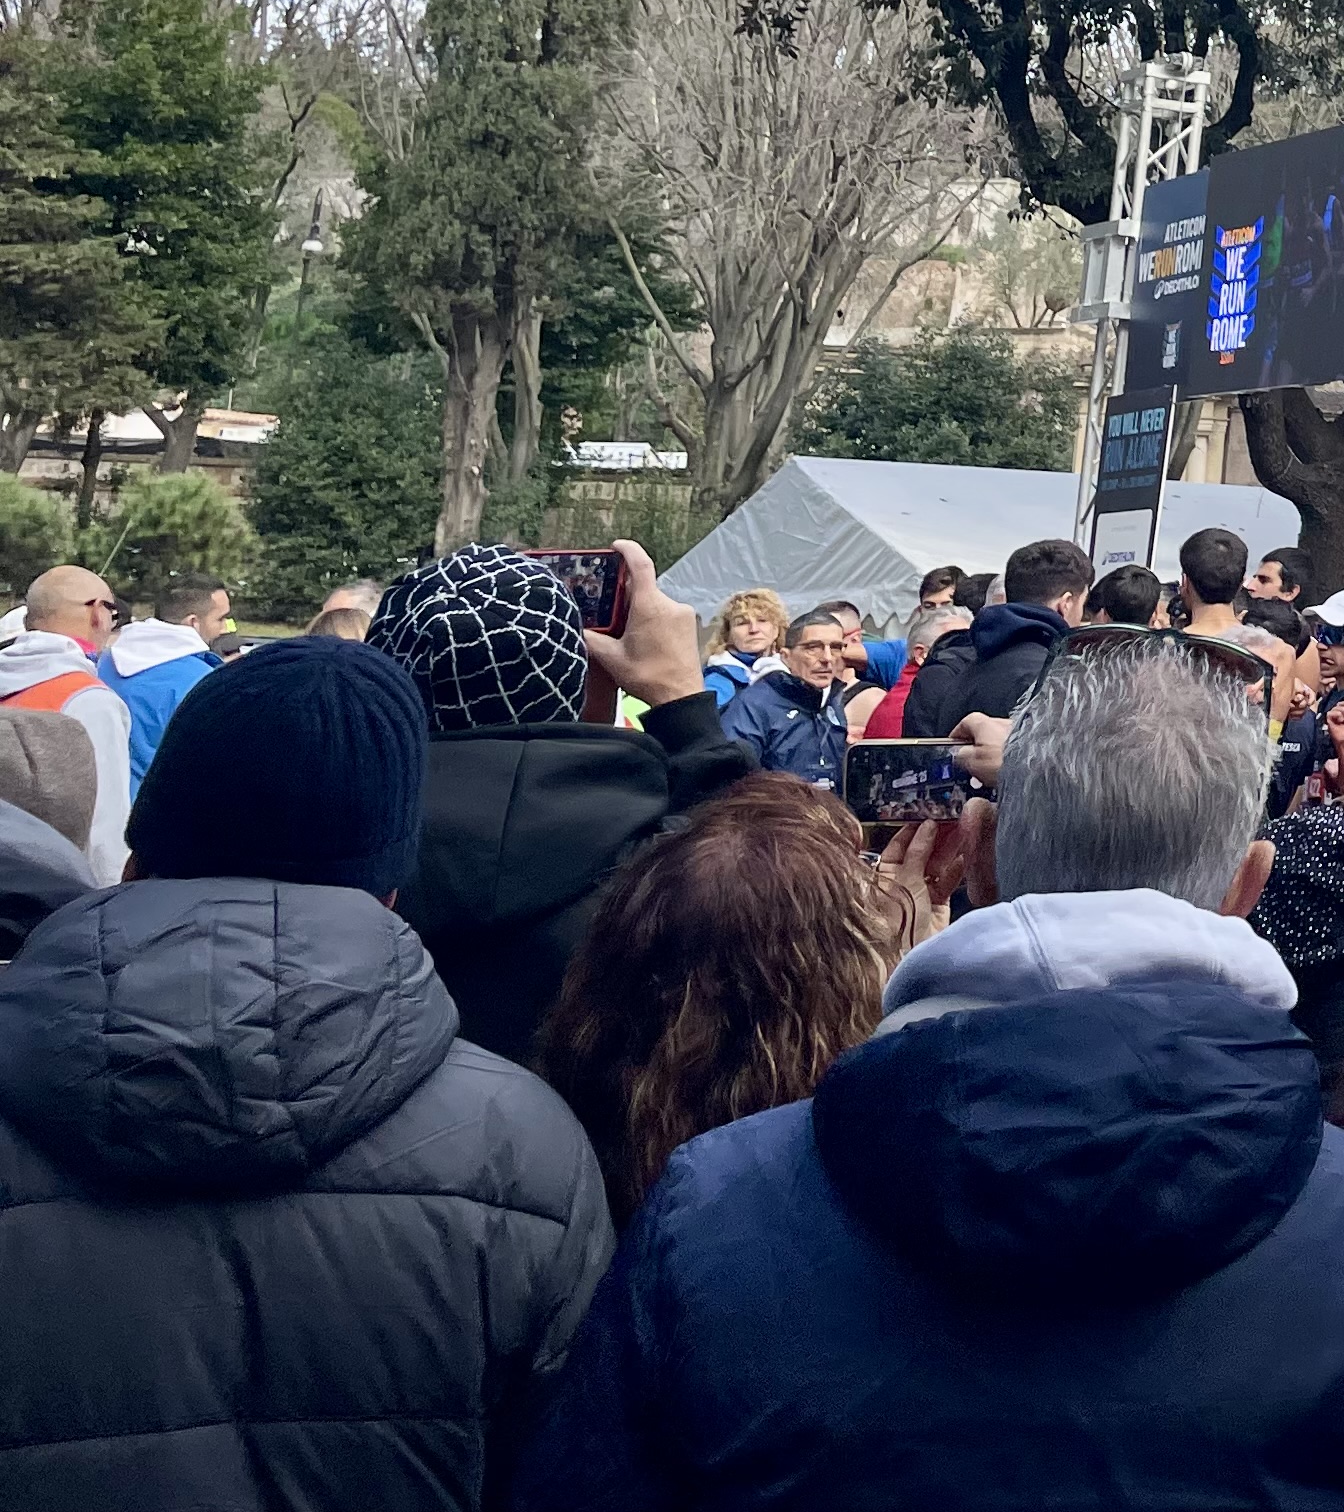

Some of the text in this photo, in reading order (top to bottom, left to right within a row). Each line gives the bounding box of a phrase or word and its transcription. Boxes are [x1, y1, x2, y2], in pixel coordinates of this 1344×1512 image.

[1138, 239, 1203, 284] WERUNROM
[1225, 245, 1247, 281] WE
[1218, 279, 1247, 317] RUN
[1210, 314, 1249, 352] ROME
[1108, 407, 1166, 438] YOU WILL NEVER
[1103, 433, 1163, 473] RUN ALONE
